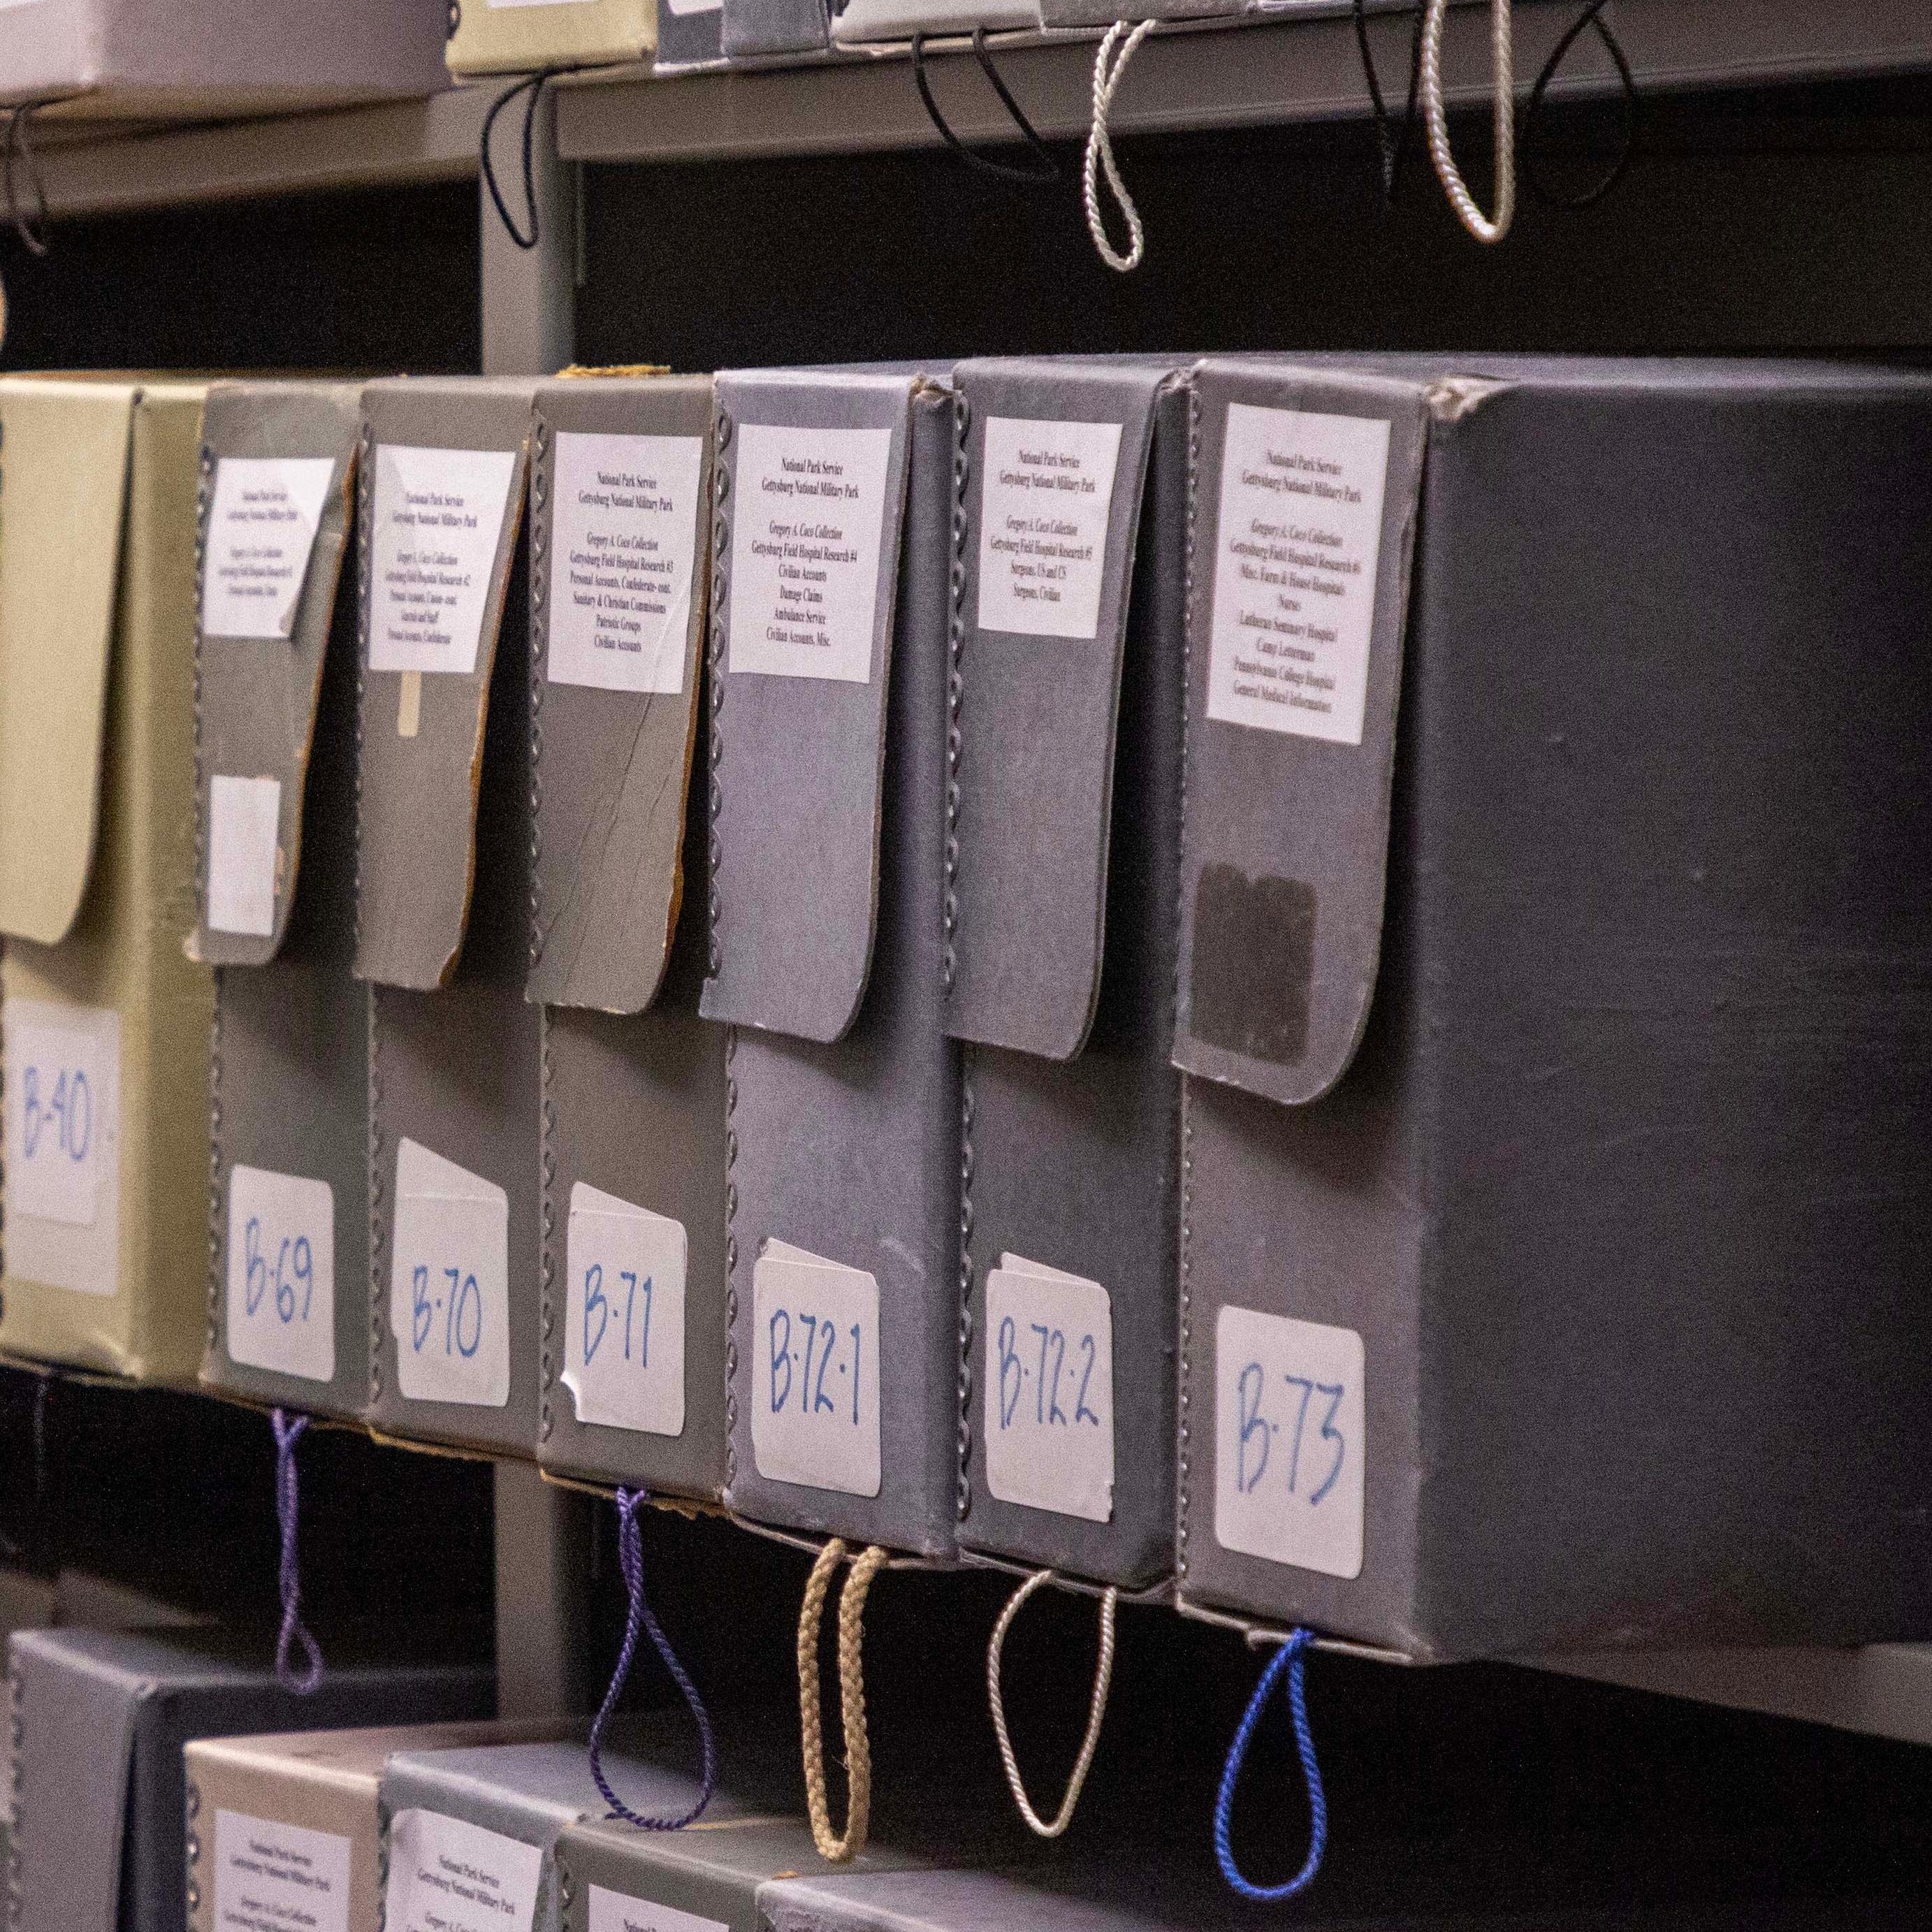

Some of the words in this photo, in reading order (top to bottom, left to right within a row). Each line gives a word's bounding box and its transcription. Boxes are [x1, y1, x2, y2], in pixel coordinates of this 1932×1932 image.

[780, 458, 806, 472] National
[807, 458, 821, 474] Park
[822, 460, 843, 476] Service
[597, 471, 620, 486] National
[622, 473, 635, 487] Park
[637, 474, 657, 489] Service
[762, 477, 793, 496] Gettysburg
[795, 480, 819, 495] National
[820, 482, 843, 500] Military
[845, 484, 859, 498] Park
[578, 490, 609, 509] Gettysburg
[611, 493, 634, 508] National
[636, 495, 658, 514] Military
[659, 497, 673, 511] Park
[751, 540, 783, 560] Gettysburg
[783, 542, 798, 558] Field
[799, 544, 822, 562] Hospital
[824, 546, 850, 562] Research
[778, 563, 800, 579] Civilian
[802, 567, 827, 582] Accounts
[780, 585, 802, 604] Damage
[803, 588, 823, 603] Claims
[806, 609, 826, 625] Service
